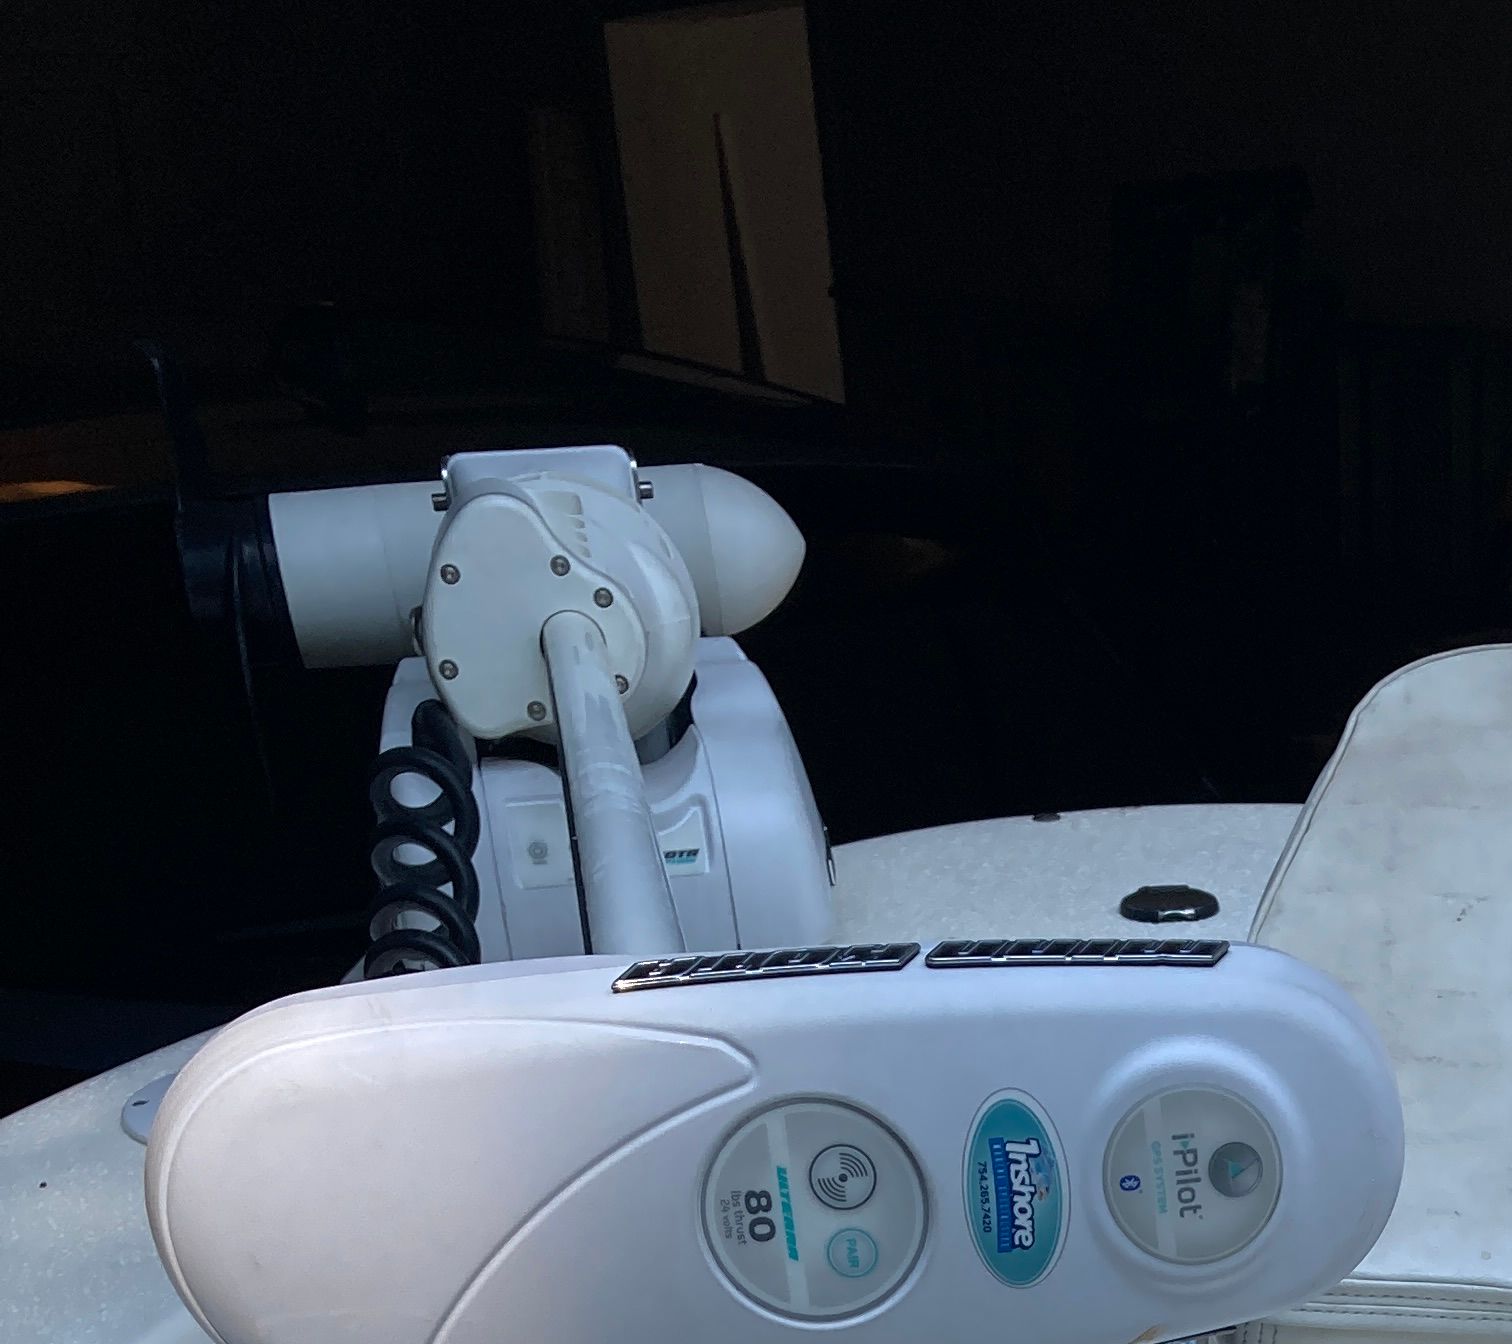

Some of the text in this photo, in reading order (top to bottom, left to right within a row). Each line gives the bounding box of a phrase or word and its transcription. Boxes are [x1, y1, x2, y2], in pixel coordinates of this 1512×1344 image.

[1151, 1140, 1168, 1214] GPS SYSTEM
[720, 1199, 733, 1240] 24 volts
[731, 1190, 748, 1246] lbs thrust
[743, 1190, 777, 1242] 80
[776, 1166, 799, 1262] ULTERRA
[846, 1238, 860, 1268] PAIR
